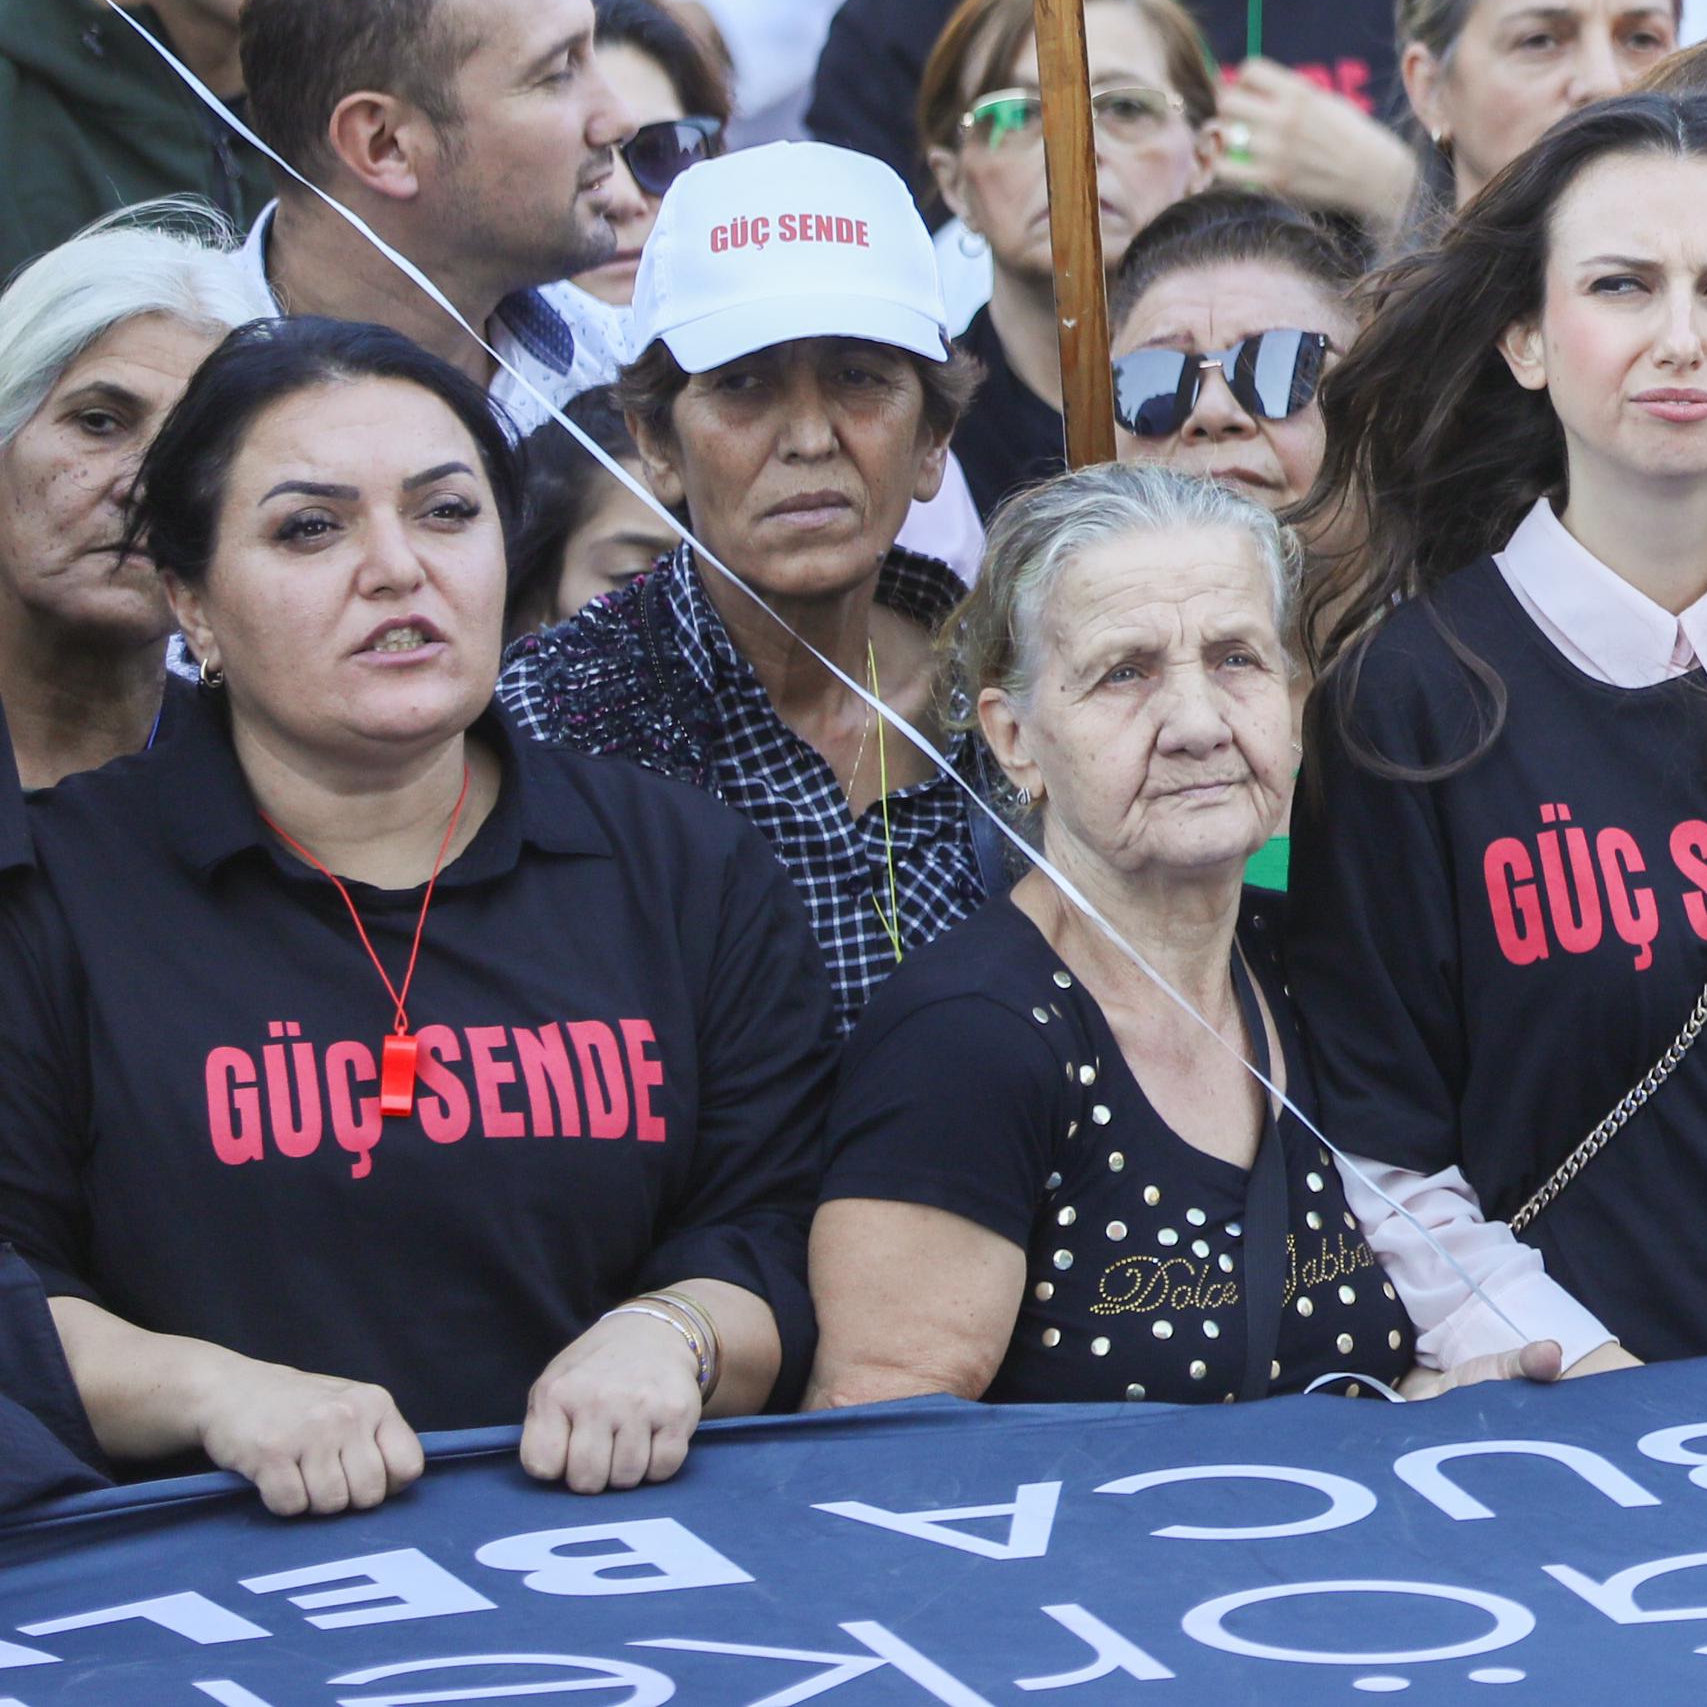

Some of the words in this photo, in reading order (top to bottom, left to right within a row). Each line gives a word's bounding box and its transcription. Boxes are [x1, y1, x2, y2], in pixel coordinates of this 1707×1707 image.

[709, 217, 770, 254] GÜÇ
[777, 211, 870, 248] SENDE
[1483, 802, 1660, 972] GÜÇ
[204, 1021, 382, 1180] GÜÇ
[412, 1018, 667, 1144] SENDE
[1089, 1254, 1239, 1316] Dolce
[0, 1517, 757, 1669] BEL
